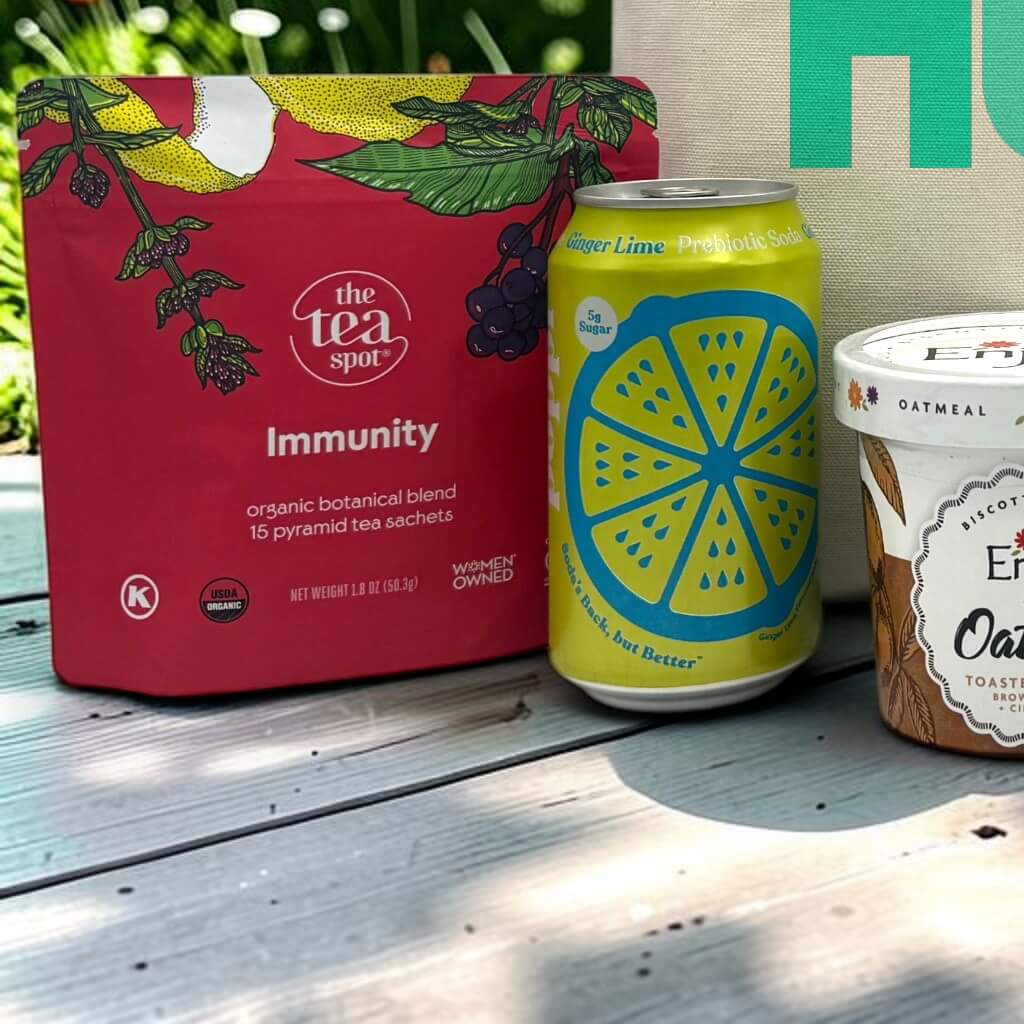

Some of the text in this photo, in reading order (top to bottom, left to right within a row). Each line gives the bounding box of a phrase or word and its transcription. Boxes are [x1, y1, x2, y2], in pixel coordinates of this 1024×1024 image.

[566, 232, 611, 254] Ginger
[613, 236, 665, 255] Lime
[677, 235, 767, 256] Prebiotic
[768, 227, 802, 246] Soda
[335, 281, 376, 305] the
[308, 307, 394, 348] tea
[587, 309, 602, 324] 5g
[578, 321, 613, 336] Sugar
[899, 399, 986, 417] OATMEAL
[267, 417, 439, 457] Immunity
[246, 483, 457, 520] organic botanical blend
[250, 509, 454, 542] 15 pyramid tea sachets
[452, 568, 513, 590] OWNED
[211, 588, 238, 599] USDA
[290, 588, 309, 602] NET
[311, 583, 349, 600] WEIGHT
[351, 581, 366, 597] 1.8
[368, 580, 380, 594] OZ
[207, 601, 242, 611] ORGANIC
[561, 543, 582, 595] Soda's
[580, 594, 610, 637] Back,
[612, 629, 639, 654] but
[641, 645, 697, 669] Better
